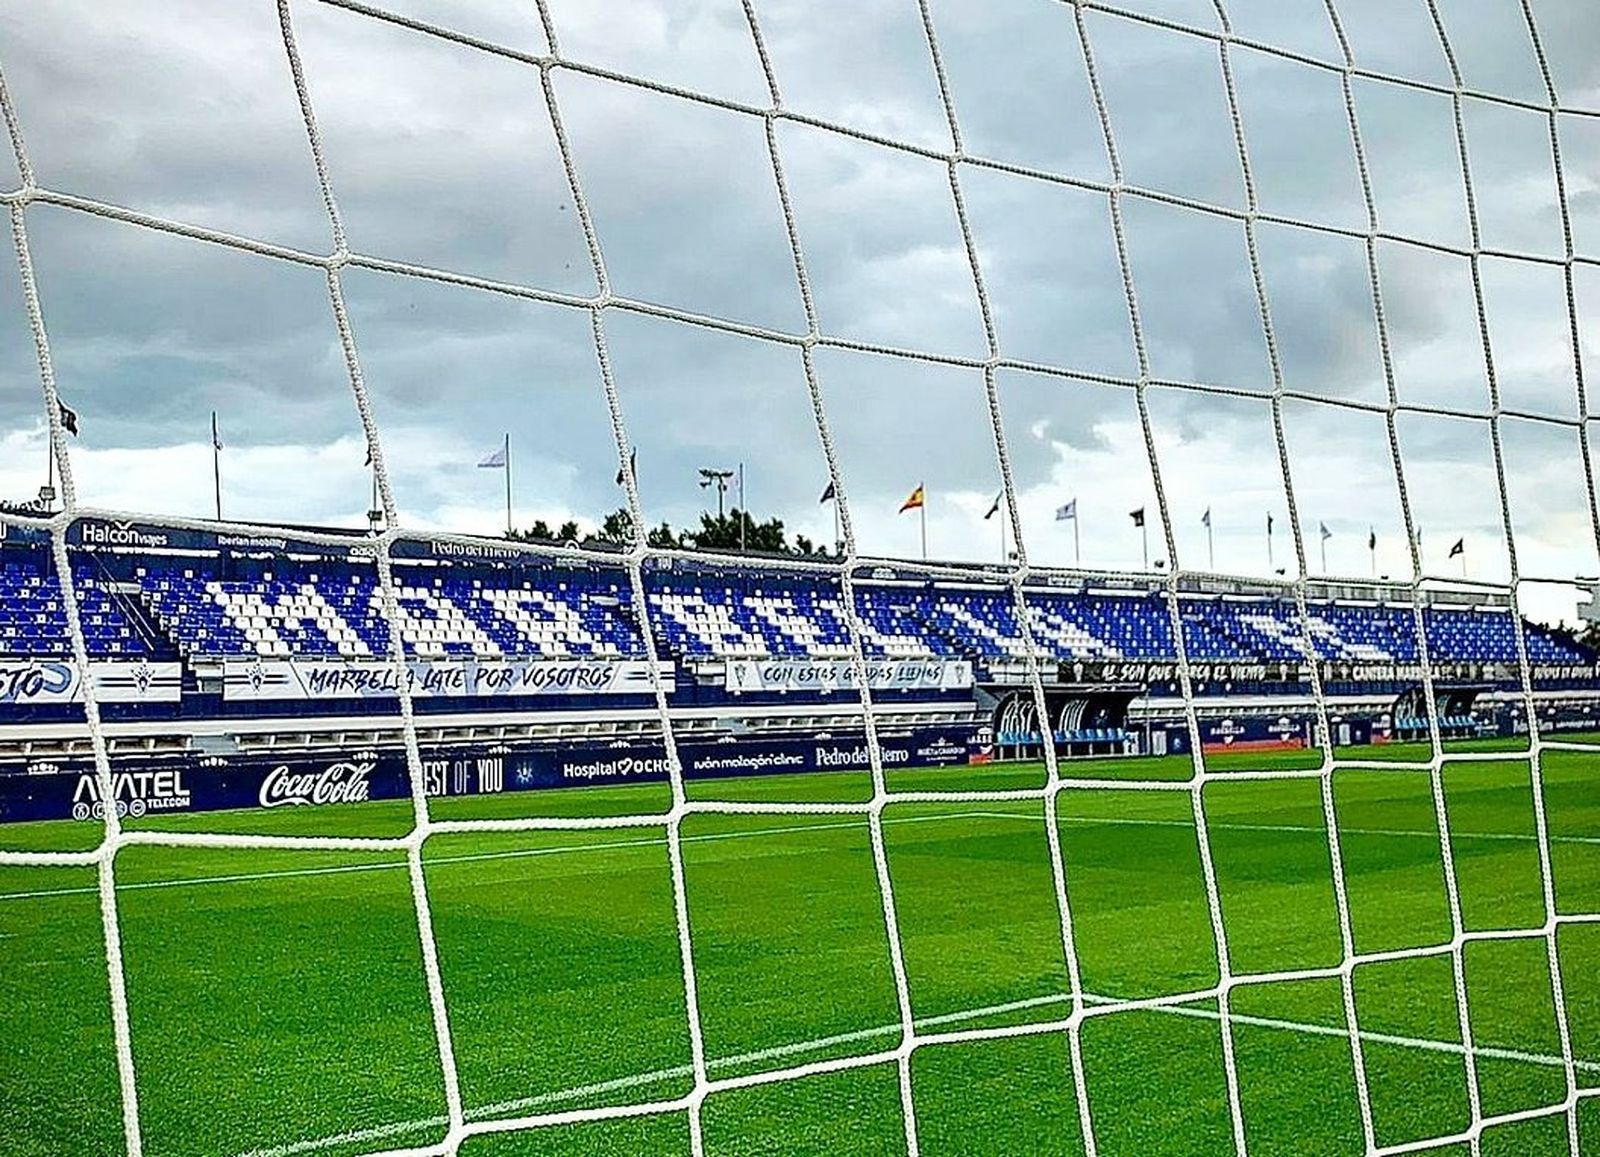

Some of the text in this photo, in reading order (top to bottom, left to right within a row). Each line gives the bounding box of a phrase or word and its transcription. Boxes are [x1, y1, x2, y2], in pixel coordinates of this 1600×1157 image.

[422, 668, 465, 689] LATE
[474, 669, 512, 688] POR
[522, 667, 614, 688] VOSOTROS
[763, 667, 793, 682] CON
[815, 747, 851, 766] Pedro
[851, 746, 869, 764] del
[423, 758, 503, 796] EST OF YOU
[563, 761, 617, 779] Hospital
[73, 771, 190, 802] AVATEL
[259, 762, 376, 807] Coca-Cola
[147, 797, 190, 809] TELECOM
